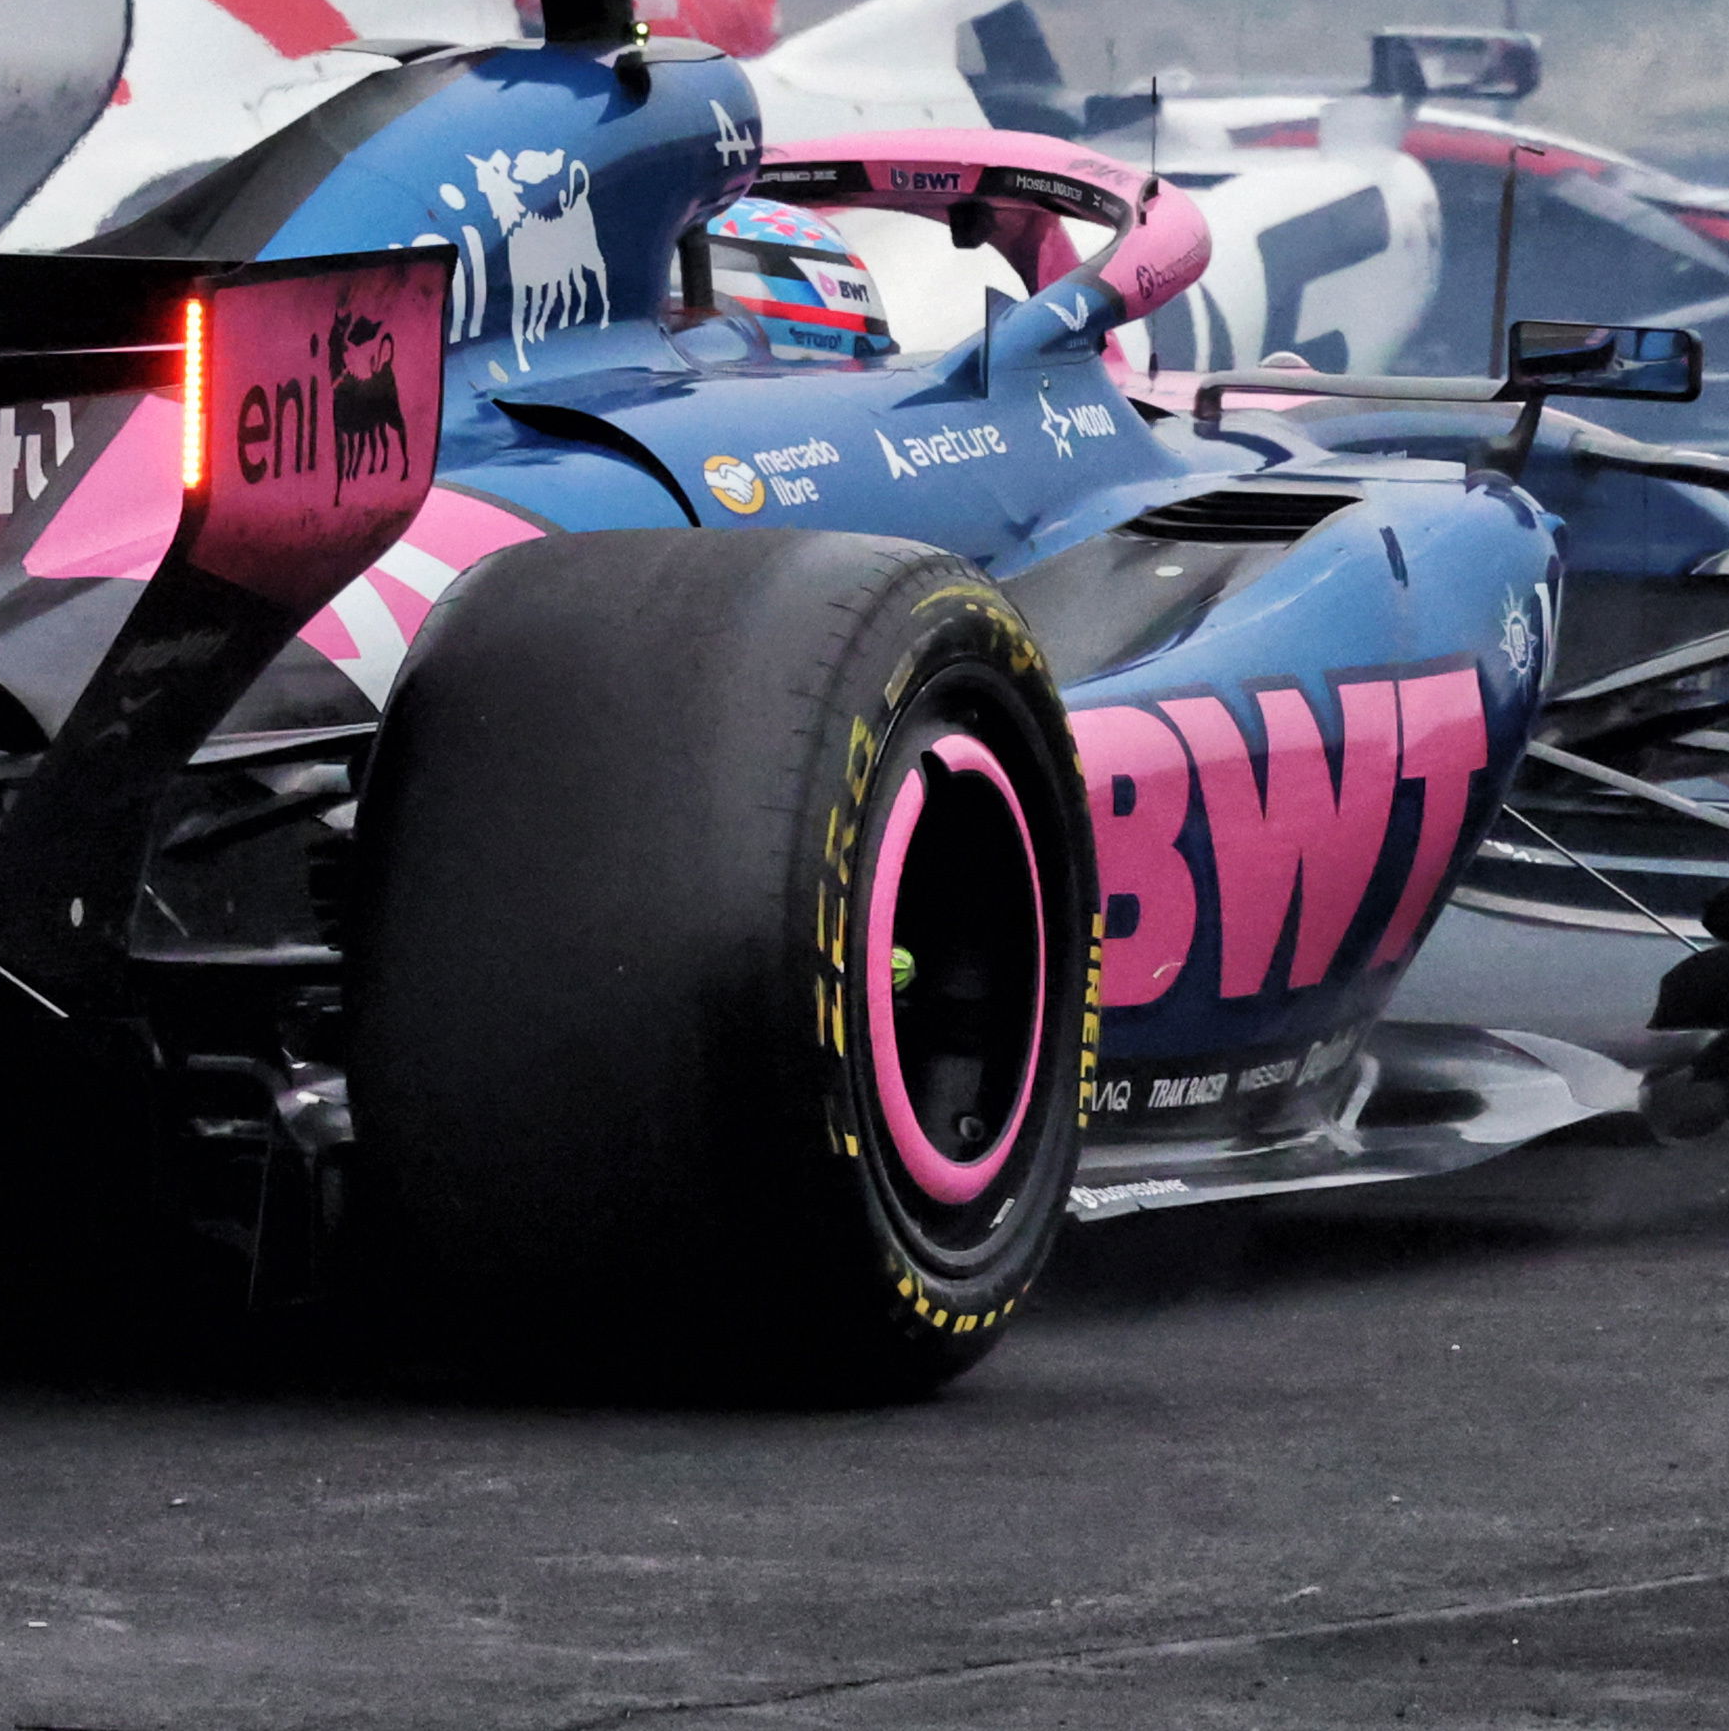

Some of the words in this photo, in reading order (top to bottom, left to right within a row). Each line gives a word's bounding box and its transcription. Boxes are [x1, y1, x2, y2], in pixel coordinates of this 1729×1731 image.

[913, 172, 962, 192] BWT
[838, 278, 871, 304] BWT
[237, 333, 320, 485] eni
[1069, 403, 1116, 439] MODO
[753, 436, 841, 476] mercado
[903, 422, 1008, 470] avature
[768, 476, 820, 506] libre
[1066, 667, 1489, 1007] BWT
